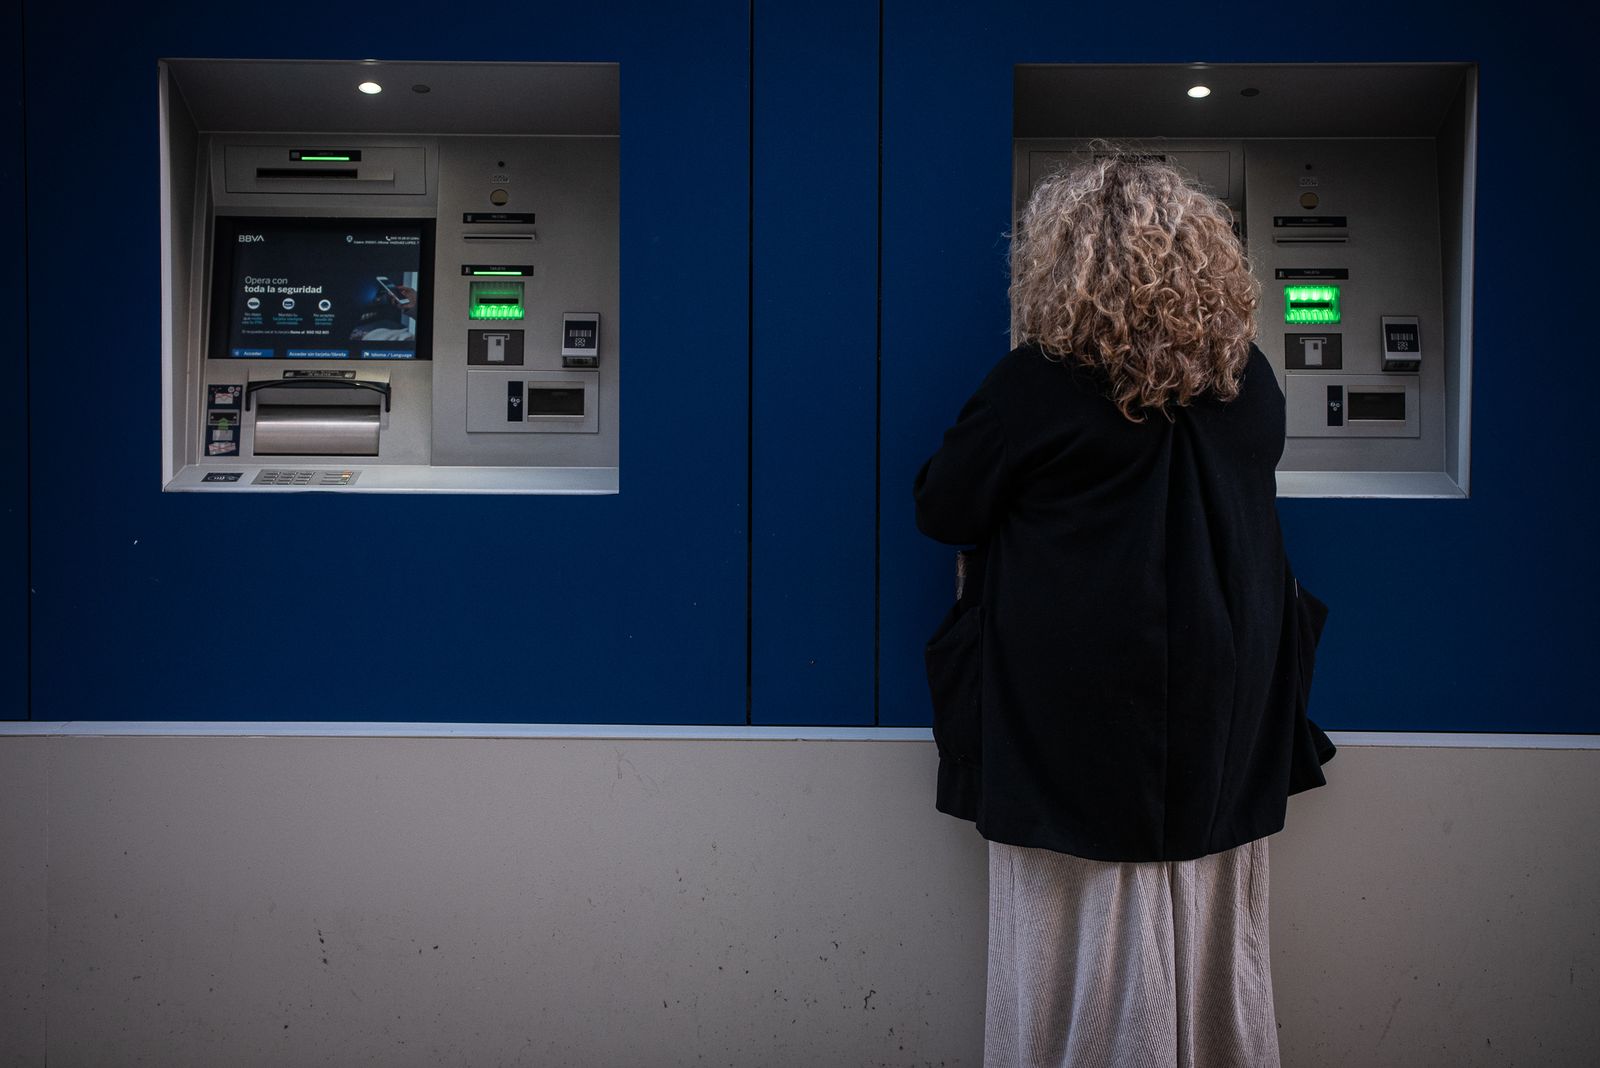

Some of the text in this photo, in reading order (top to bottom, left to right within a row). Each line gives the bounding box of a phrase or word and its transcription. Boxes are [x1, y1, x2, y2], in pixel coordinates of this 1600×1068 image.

[238, 234, 265, 243] BBVA
[244, 276, 288, 286] Opera con
[244, 285, 323, 295] toda la seguridad
